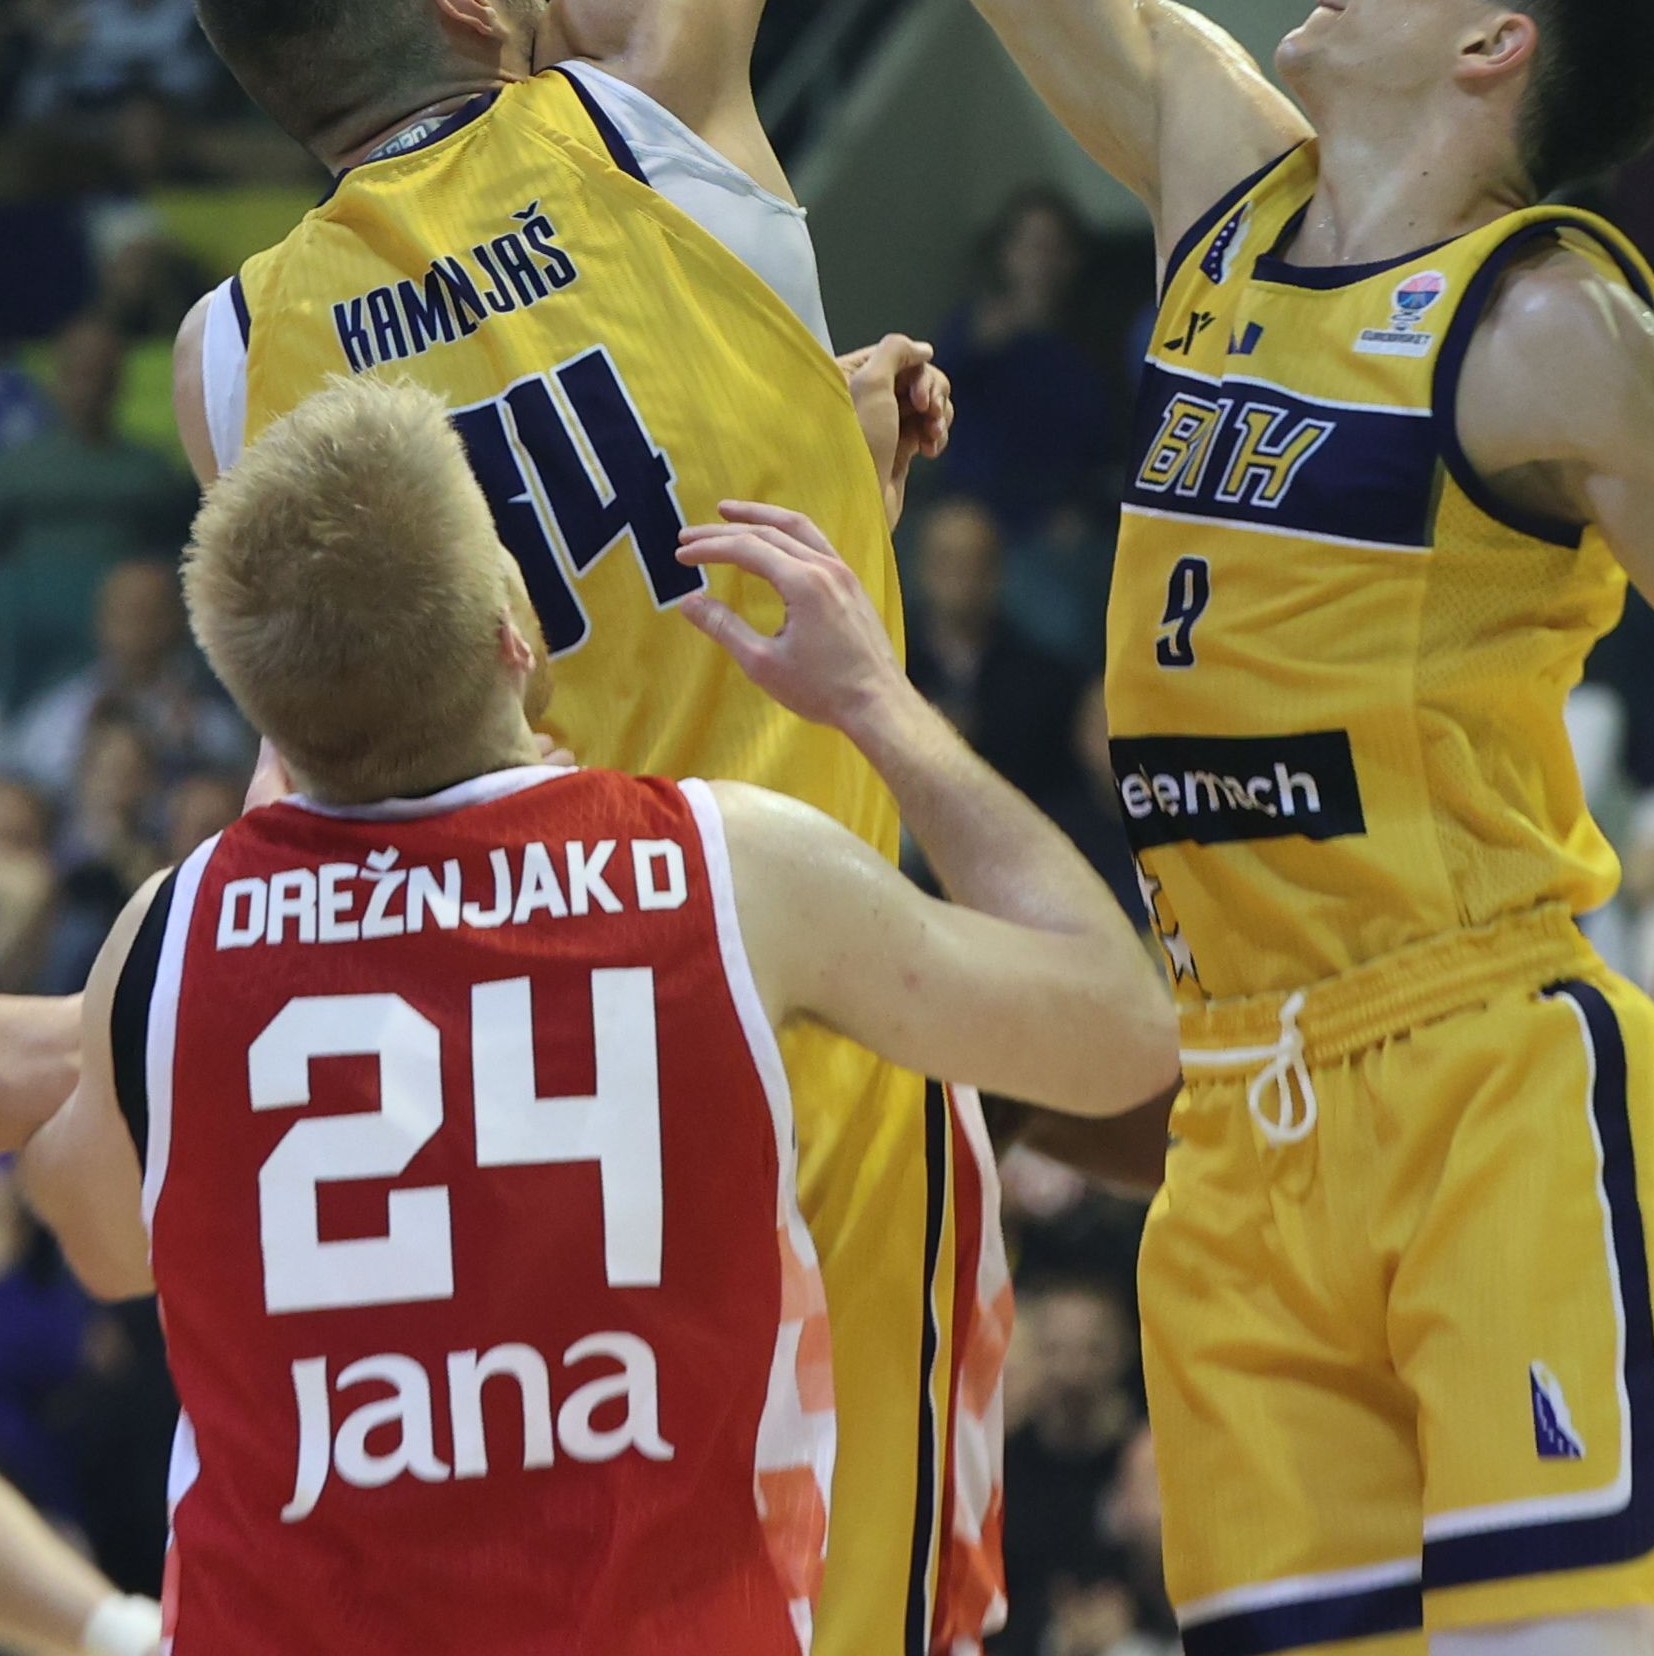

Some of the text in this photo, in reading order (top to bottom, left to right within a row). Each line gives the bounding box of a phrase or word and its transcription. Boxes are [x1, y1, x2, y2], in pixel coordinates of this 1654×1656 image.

[447, 344, 710, 659] 14
[1135, 392, 1337, 509] BIH
[1155, 555, 1210, 670] 9
[215, 838, 688, 952] DREŽNJAK D
[247, 966, 664, 1315] 24
[280, 1331, 676, 1524] jana
